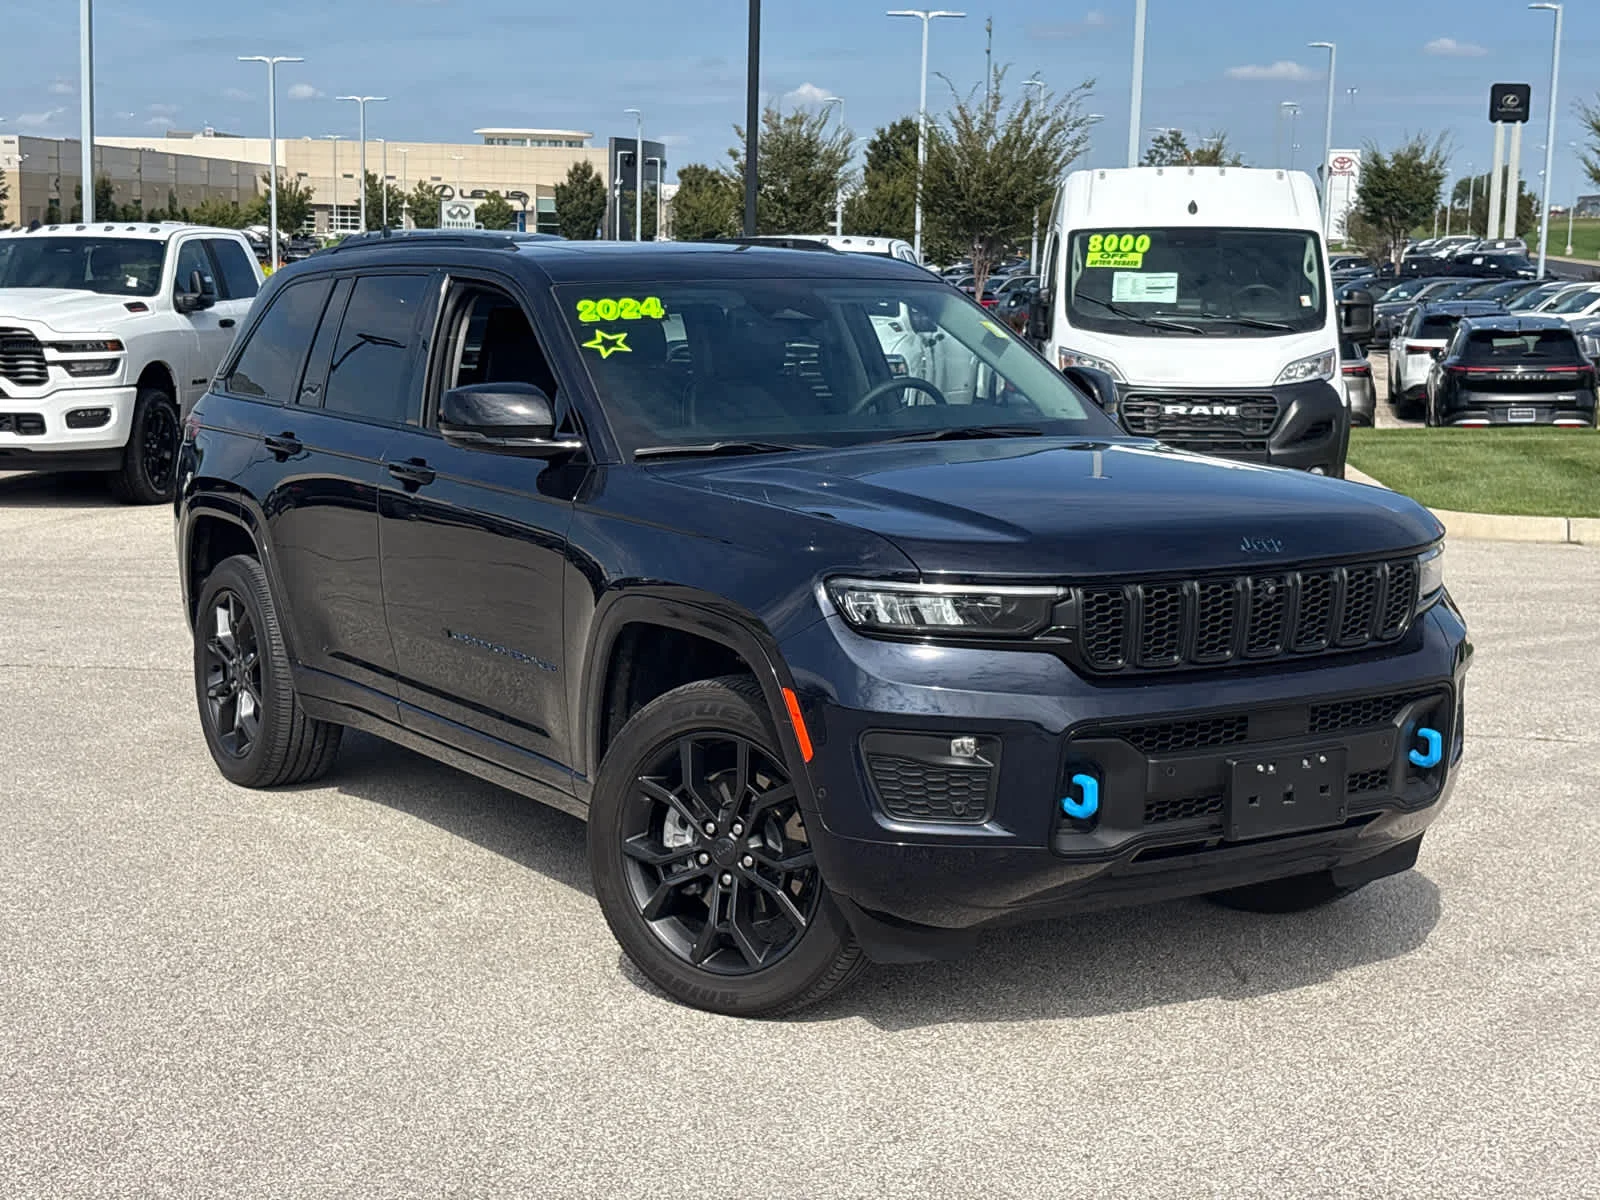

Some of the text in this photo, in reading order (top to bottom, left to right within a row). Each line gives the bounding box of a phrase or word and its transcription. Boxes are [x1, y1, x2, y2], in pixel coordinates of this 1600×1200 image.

[459, 188, 530, 200] LEUS
[1087, 234, 1151, 253] 8000
[576, 296, 665, 322] 2024
[1164, 405, 1237, 416] RAM
